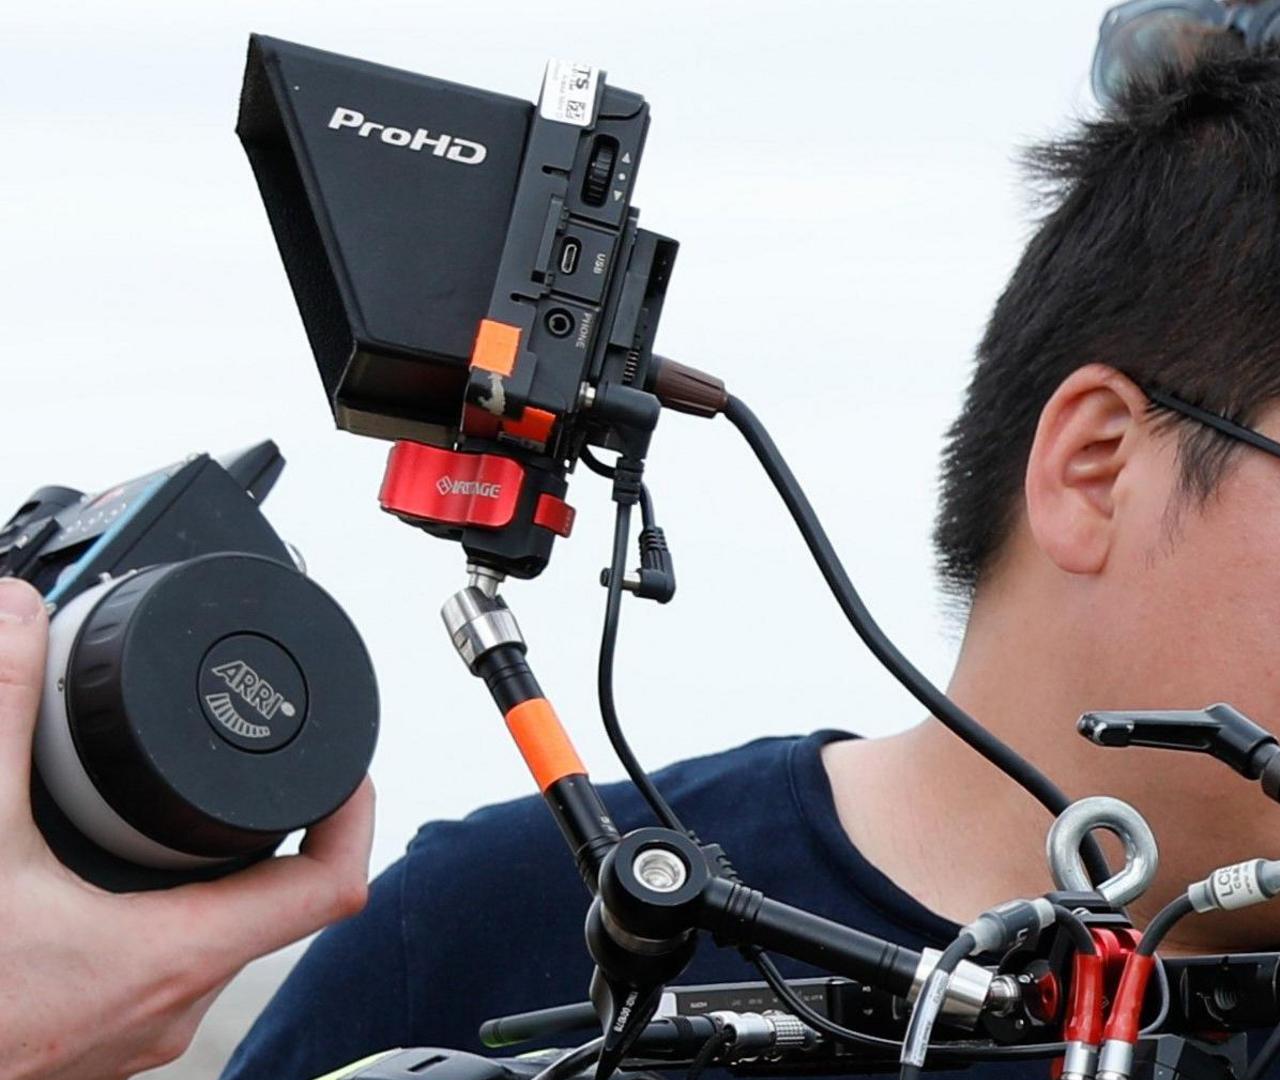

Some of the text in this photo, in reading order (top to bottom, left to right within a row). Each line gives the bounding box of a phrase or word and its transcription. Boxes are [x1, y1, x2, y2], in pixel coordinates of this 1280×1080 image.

[327, 106, 488, 165] ProHD
[594, 253, 606, 274] USB
[576, 312, 592, 348] PHONE
[211, 660, 284, 720] ARRI
